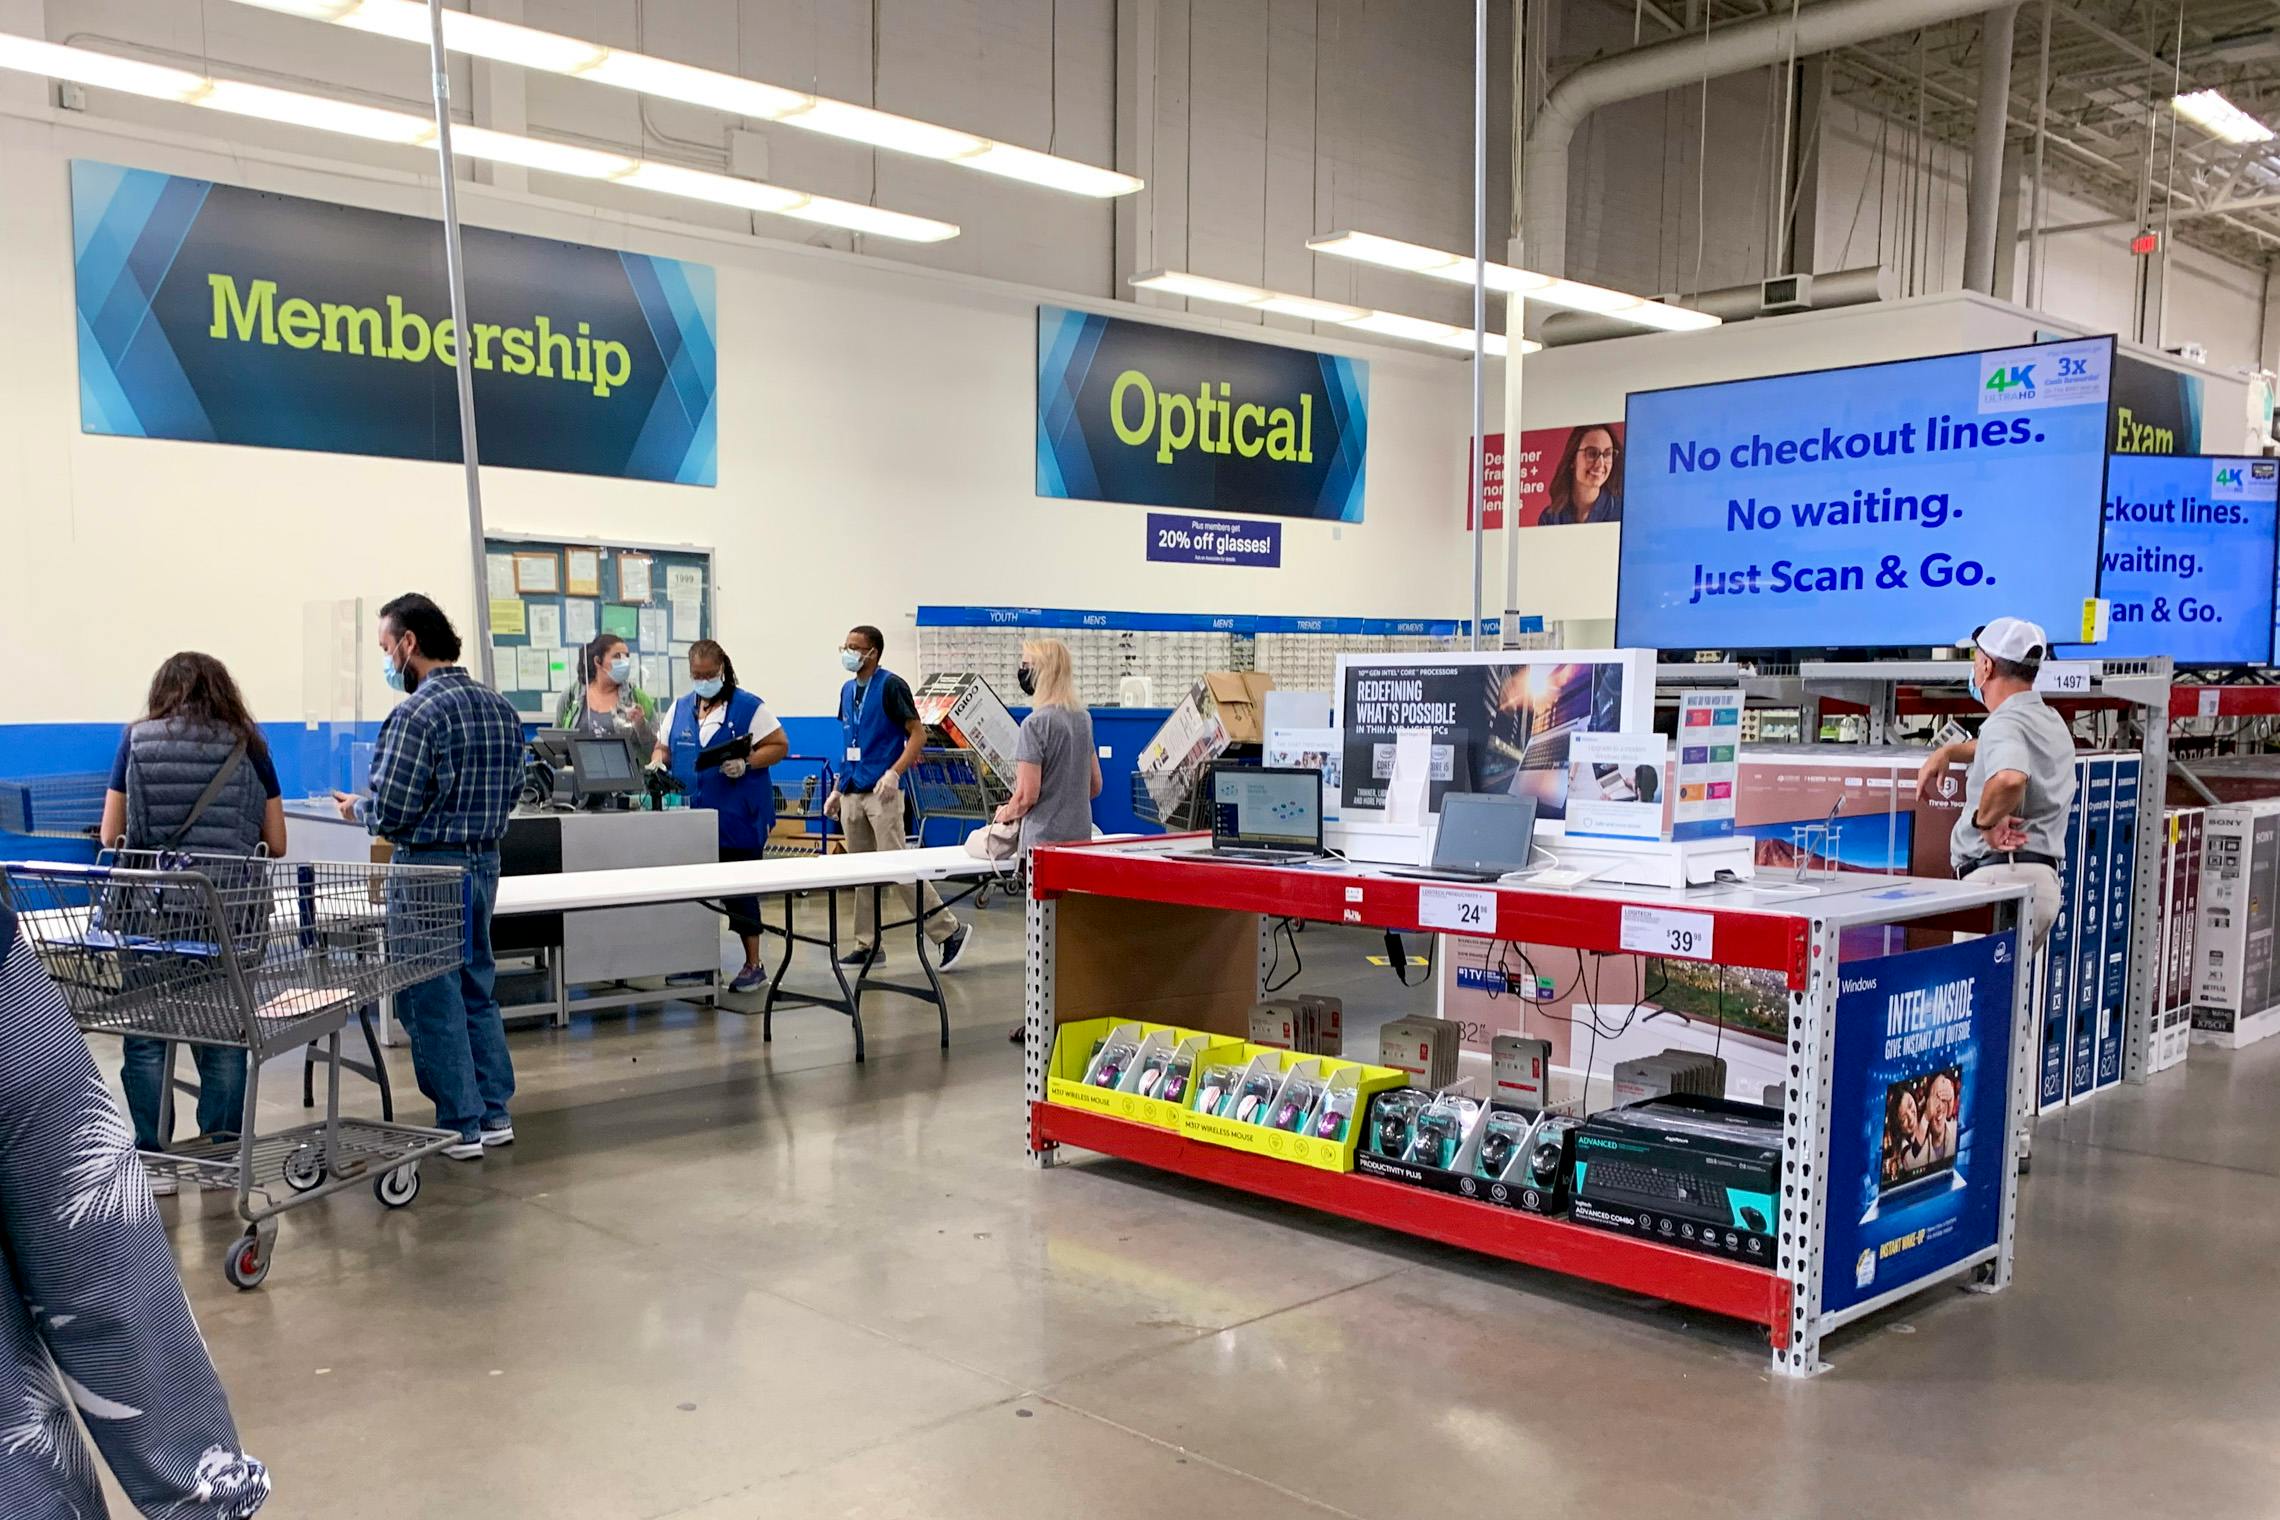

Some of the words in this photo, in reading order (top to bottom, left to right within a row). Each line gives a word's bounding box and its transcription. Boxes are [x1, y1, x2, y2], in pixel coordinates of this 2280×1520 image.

[208, 273, 631, 397] Membership
[2058, 357, 2087, 377] 3x
[1986, 364, 2037, 392] 4K
[1110, 370, 1312, 464] Optical
[2116, 407, 2174, 453] Exam
[1668, 440, 1721, 474] No
[1730, 422, 1915, 468] checkout
[1926, 414, 2046, 453] lines.
[1485, 451, 1542, 466] Dener
[1484, 467, 1528, 481] fras
[1727, 498, 1781, 532] No
[1791, 487, 1963, 528] waiting.
[2105, 496, 2175, 523] ckout
[2181, 497, 2249, 524] lines.
[1192, 520, 1204, 530] Plus
[1205, 522, 1231, 532] members
[1231, 524, 1241, 534] get
[1159, 530, 1190, 549] 20%
[1194, 532, 1214, 550] off
[1217, 534, 1271, 555] glasses!
[2102, 546, 2203, 579] waiting.
[1689, 563, 1761, 604] Just
[1770, 560, 1864, 593] Scan
[1875, 554, 1909, 590] &
[1919, 552, 1996, 588] Go.
[990, 611, 1018, 622] YOUTH
[1083, 614, 1107, 625] MEN'S
[2111, 602, 2144, 622] an
[2151, 597, 2170, 622] &
[2178, 597, 2222, 623] Go.
[1213, 618, 1234, 629] MEN'S
[1297, 621, 1322, 631] TRENDS
[1420, 668, 1458, 676] PROCESSORS
[1357, 680, 1422, 702] REDEFINING
[1356, 702, 1399, 724] WHAT'S
[1401, 702, 1456, 725] POSSIBLE
[1356, 725, 1365, 734] IN
[1366, 725, 1386, 735] THIN
[1433, 726, 1449, 735] PCs
[2256, 830, 2274, 844] SONY
[1469, 968, 1483, 980] TV
[1841, 977, 1877, 994] Windows
[1887, 988, 1926, 1037] INTEL
[1932, 977, 1975, 1026] INSIDE
[1885, 1037, 1902, 1060] GIVE
[1903, 1030, 1932, 1055] INSTANT
[1932, 1027, 1946, 1049] JOY
[1946, 1020, 1971, 1045] OUTSIDE
[1065, 1091, 1089, 1102] WIRELESS
[1090, 1096, 1110, 1106] MOUSE
[1185, 1121, 1200, 1129] M317
[1201, 1124, 1230, 1136] WIRELESS
[1231, 1131, 1254, 1142] MOUSE
[1578, 1136, 1618, 1150] ADVANCED
[1360, 1158, 1404, 1176] PRODUCTIVITY
[1405, 1169, 1422, 1180] PLUS
[1575, 1207, 1609, 1220] ADVANCED
[1610, 1214, 1635, 1226] COMBO
